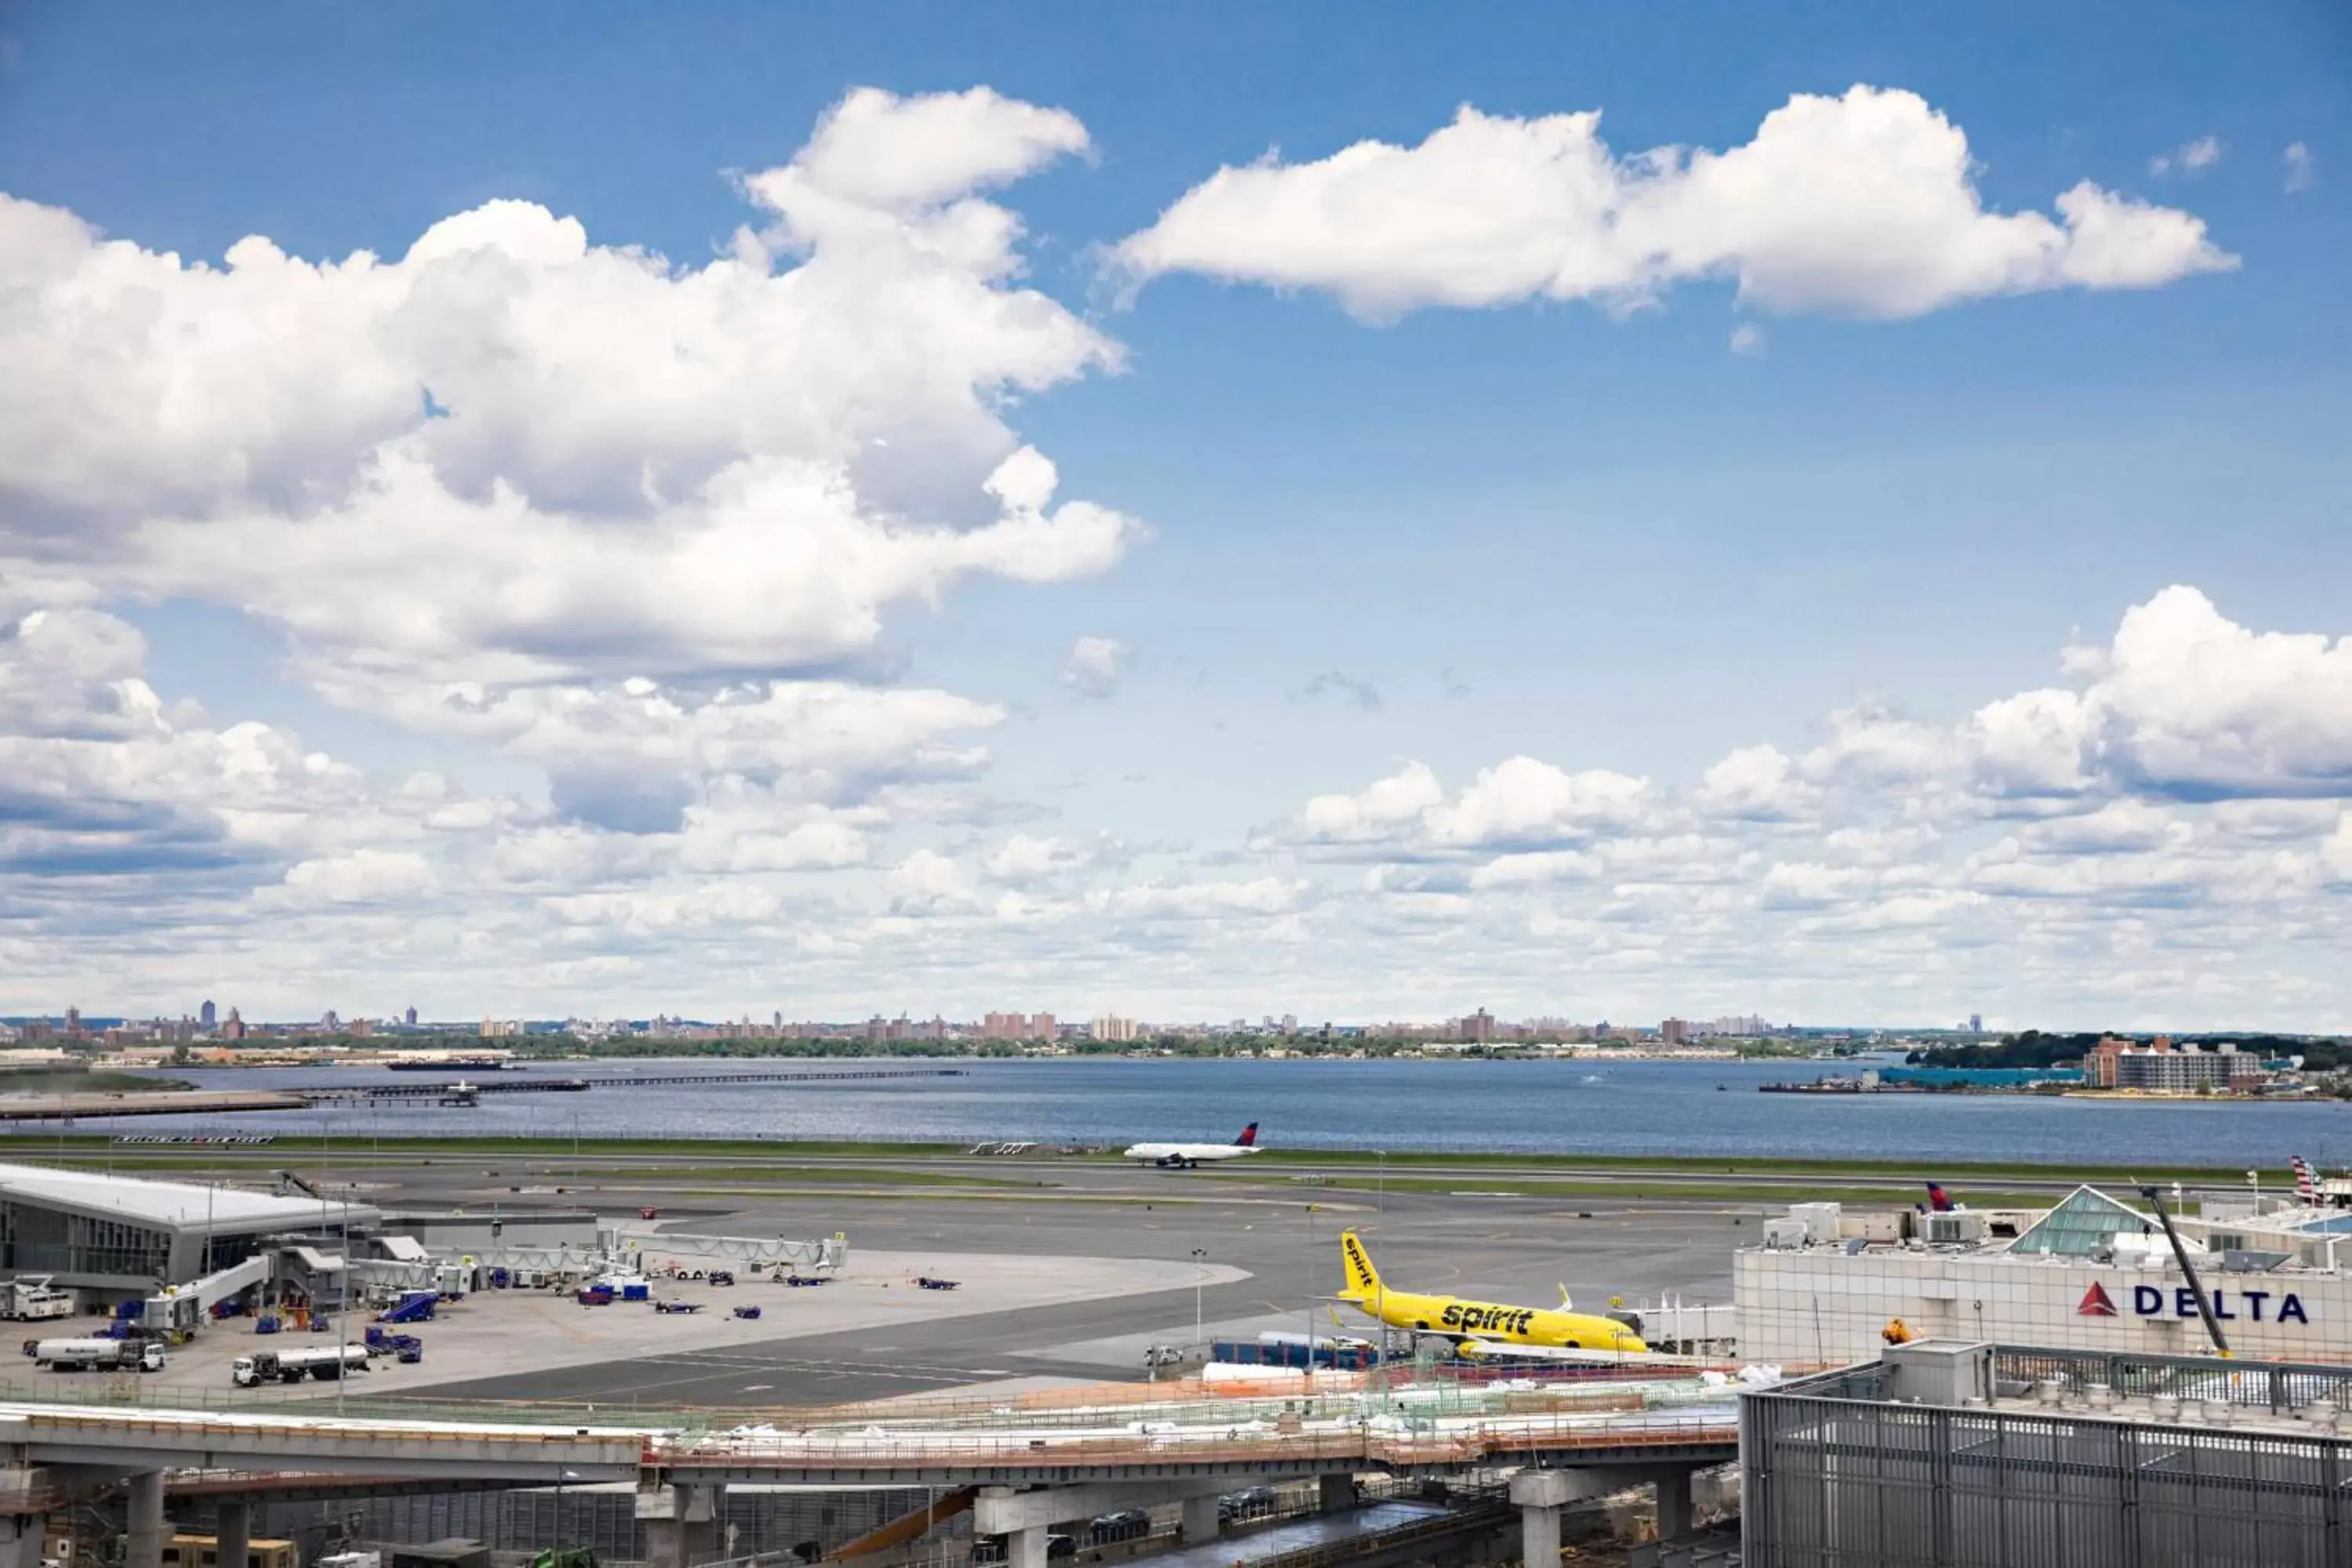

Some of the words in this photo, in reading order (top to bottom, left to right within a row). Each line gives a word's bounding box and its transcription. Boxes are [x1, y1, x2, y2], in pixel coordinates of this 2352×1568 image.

[1346, 1238, 1373, 1287] spirit
[1441, 1305, 1534, 1334] spirit
[2133, 1286, 2309, 1323] DELTA
